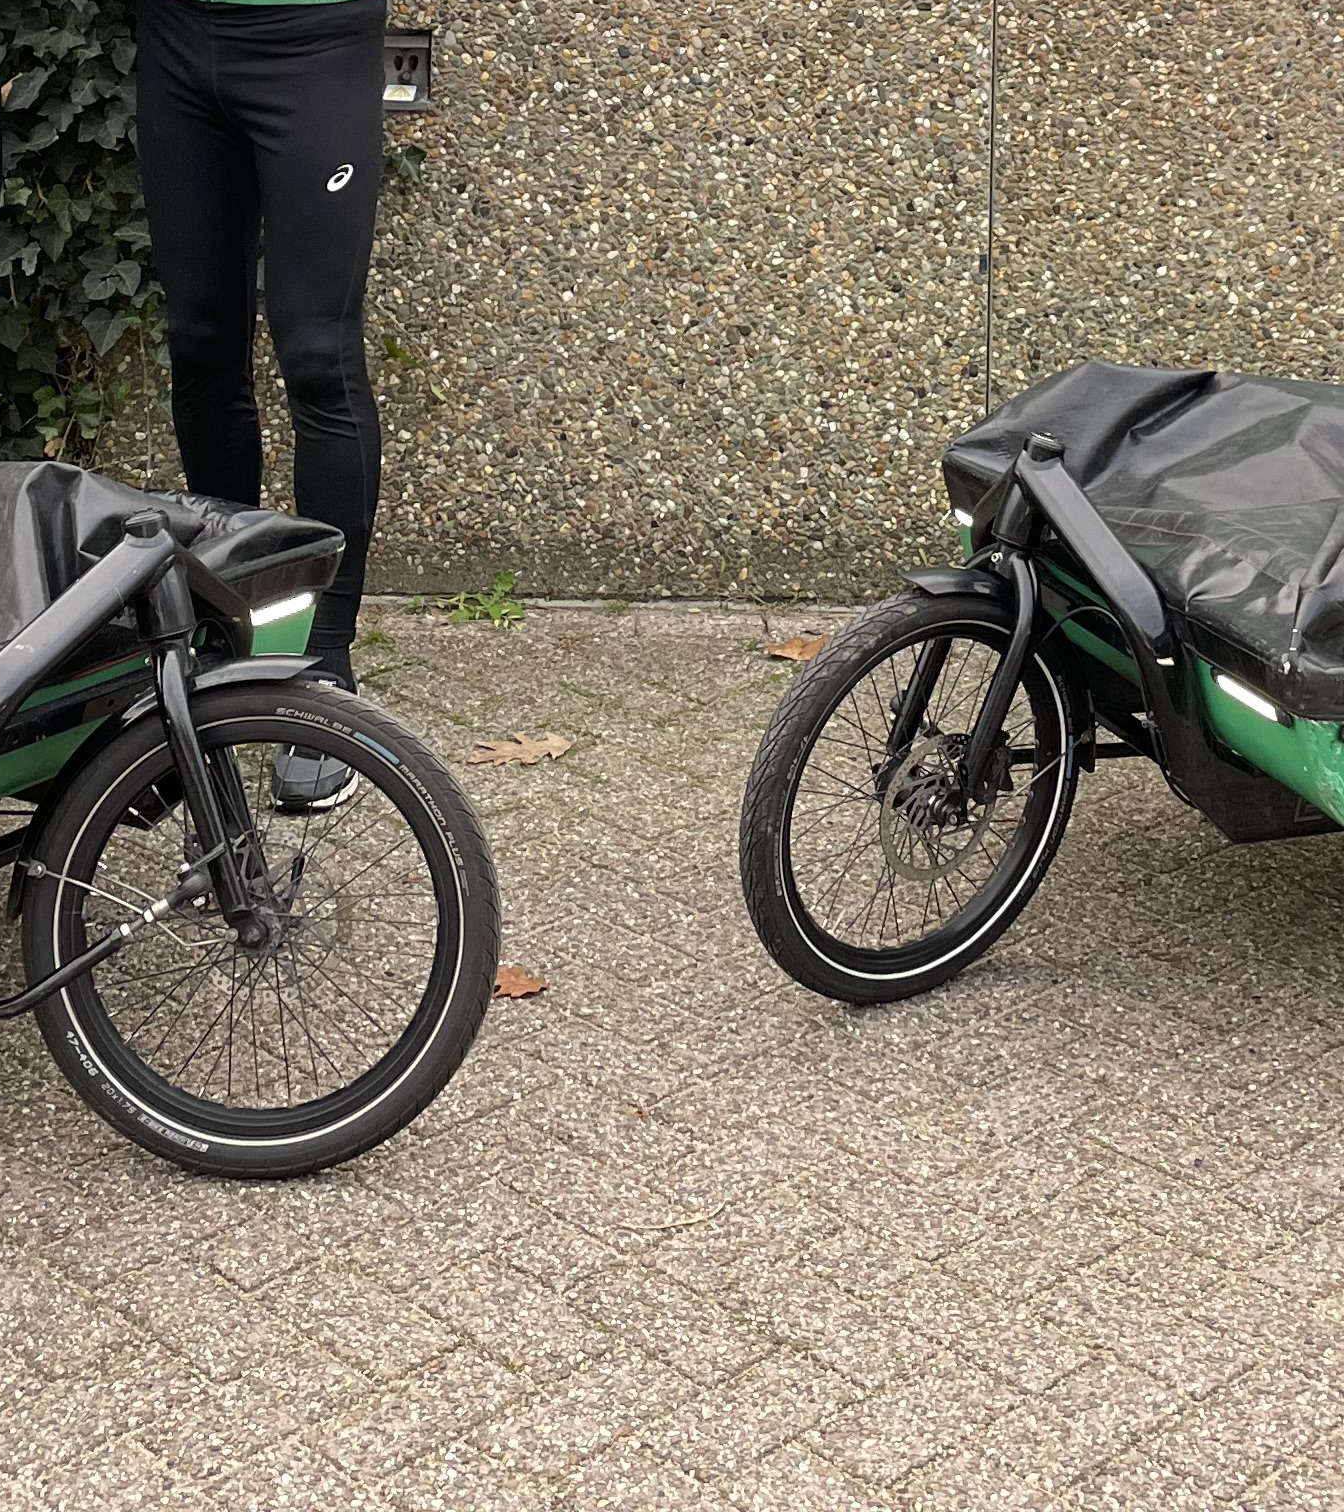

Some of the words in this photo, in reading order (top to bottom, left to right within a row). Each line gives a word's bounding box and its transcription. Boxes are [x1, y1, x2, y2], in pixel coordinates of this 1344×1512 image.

[275, 707, 354, 734] SCHWALBE
[399, 764, 447, 827] MARATHON
[445, 831, 464, 867] PLUS
[66, 1030, 99, 1077] 47-406
